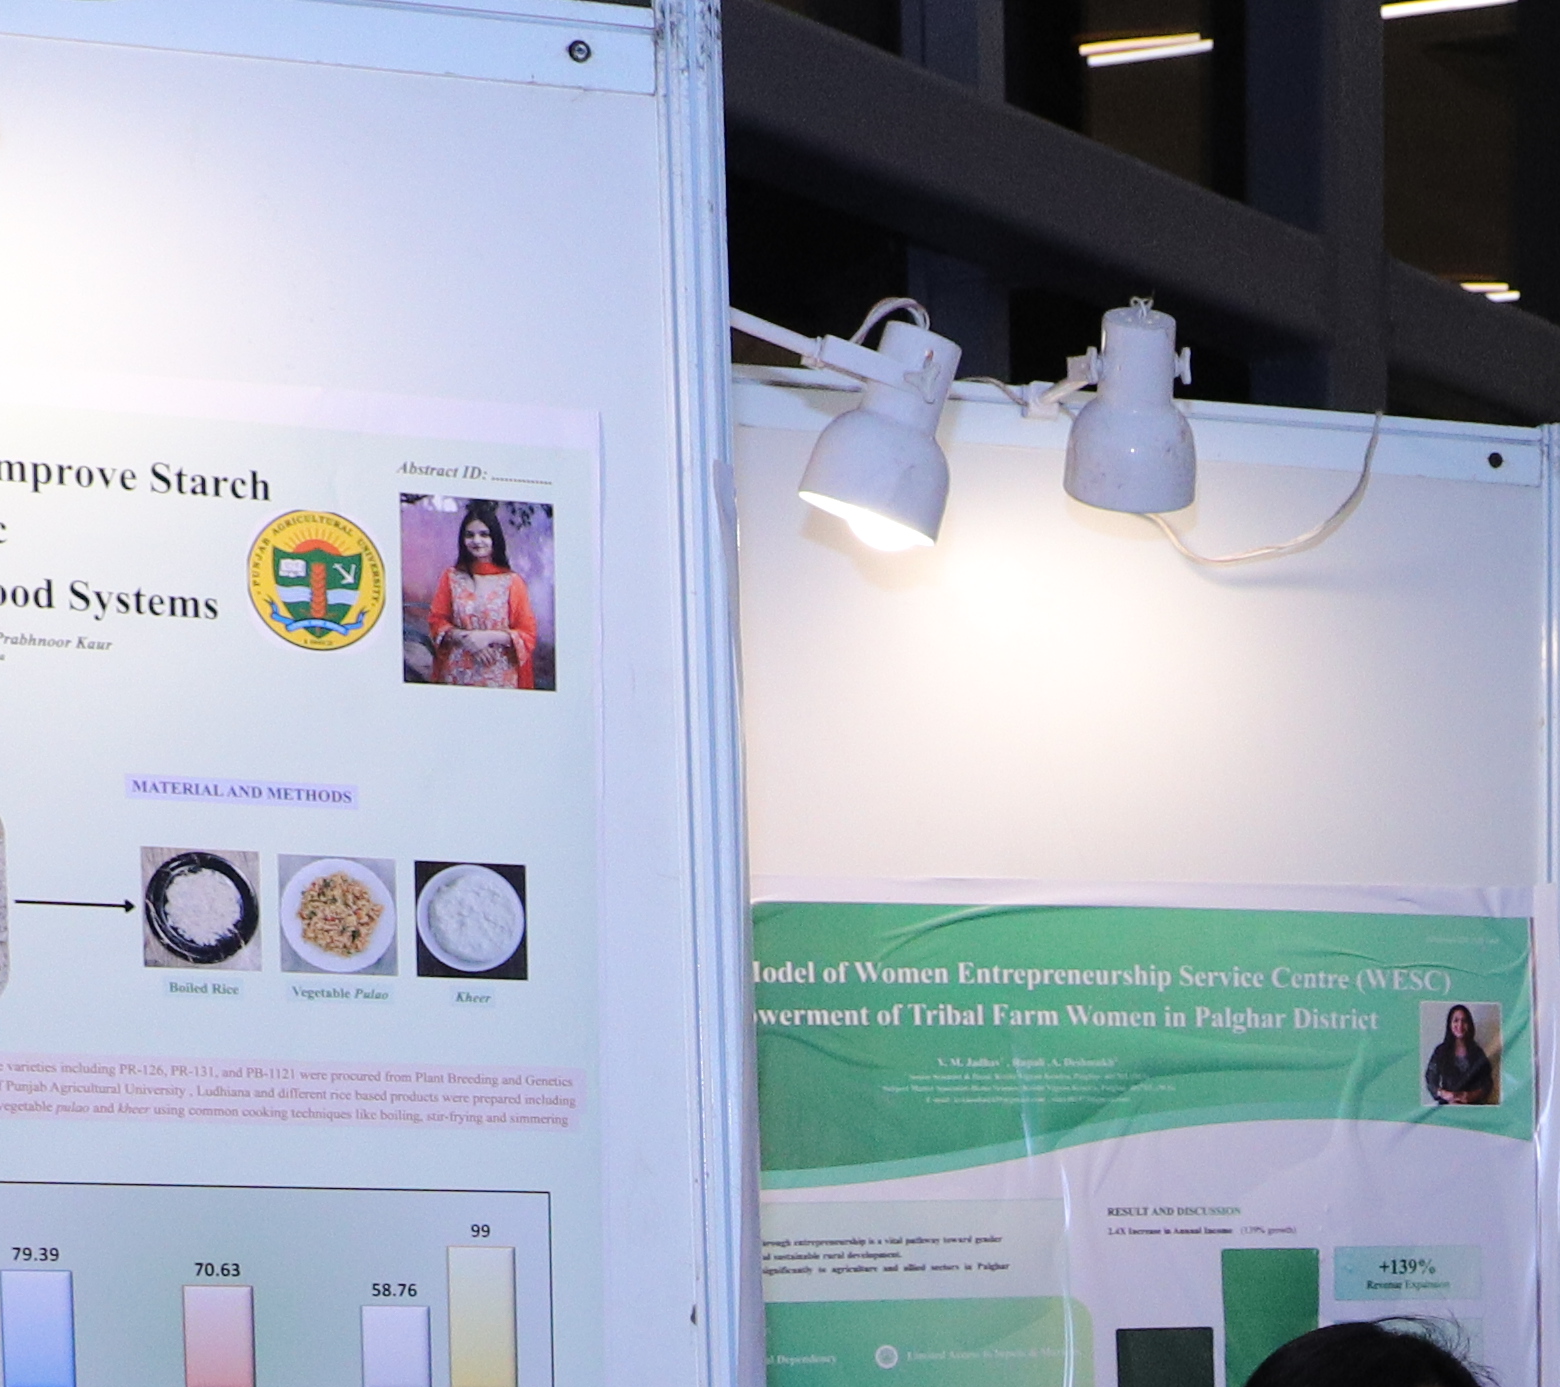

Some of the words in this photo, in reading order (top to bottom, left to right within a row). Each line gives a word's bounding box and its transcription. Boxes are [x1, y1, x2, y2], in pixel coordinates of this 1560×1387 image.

[397, 460, 450, 478] Abstract
[453, 464, 488, 482] ID:
[151, 463, 270, 501] Starch
[69, 580, 218, 621] Systems
[75, 636, 113, 651] Kaur
[132, 779, 224, 797] MATERIAL
[227, 785, 263, 799] AND
[267, 787, 352, 804] METHODS
[823, 961, 849, 983] of
[853, 961, 950, 984] Women
[958, 961, 1173, 993] Entrepreneurship
[1179, 964, 1265, 989] Service
[1271, 967, 1350, 991] Centre
[1355, 968, 1453, 996] (WESC)
[169, 981, 209, 994] Boiled
[211, 983, 240, 995] Rice
[291, 985, 351, 1001] Vegetable
[354, 987, 389, 1000] Pulao
[455, 991, 492, 1004] Kheer
[876, 1003, 904, 1026] of
[907, 1003, 984, 1026] Tribal
[992, 1003, 1059, 1026] Farm
[1065, 1004, 1156, 1027] Women
[1164, 1005, 1186, 1027] in
[1195, 1006, 1287, 1034] Palghar
[1294, 1007, 1378, 1030] District
[470, 1223, 491, 1238] 99
[11, 1246, 60, 1262] 79.39
[194, 1262, 241, 1277] 70.63
[1378, 1258, 1436, 1275] +139%
[372, 1282, 418, 1298] 58.76
